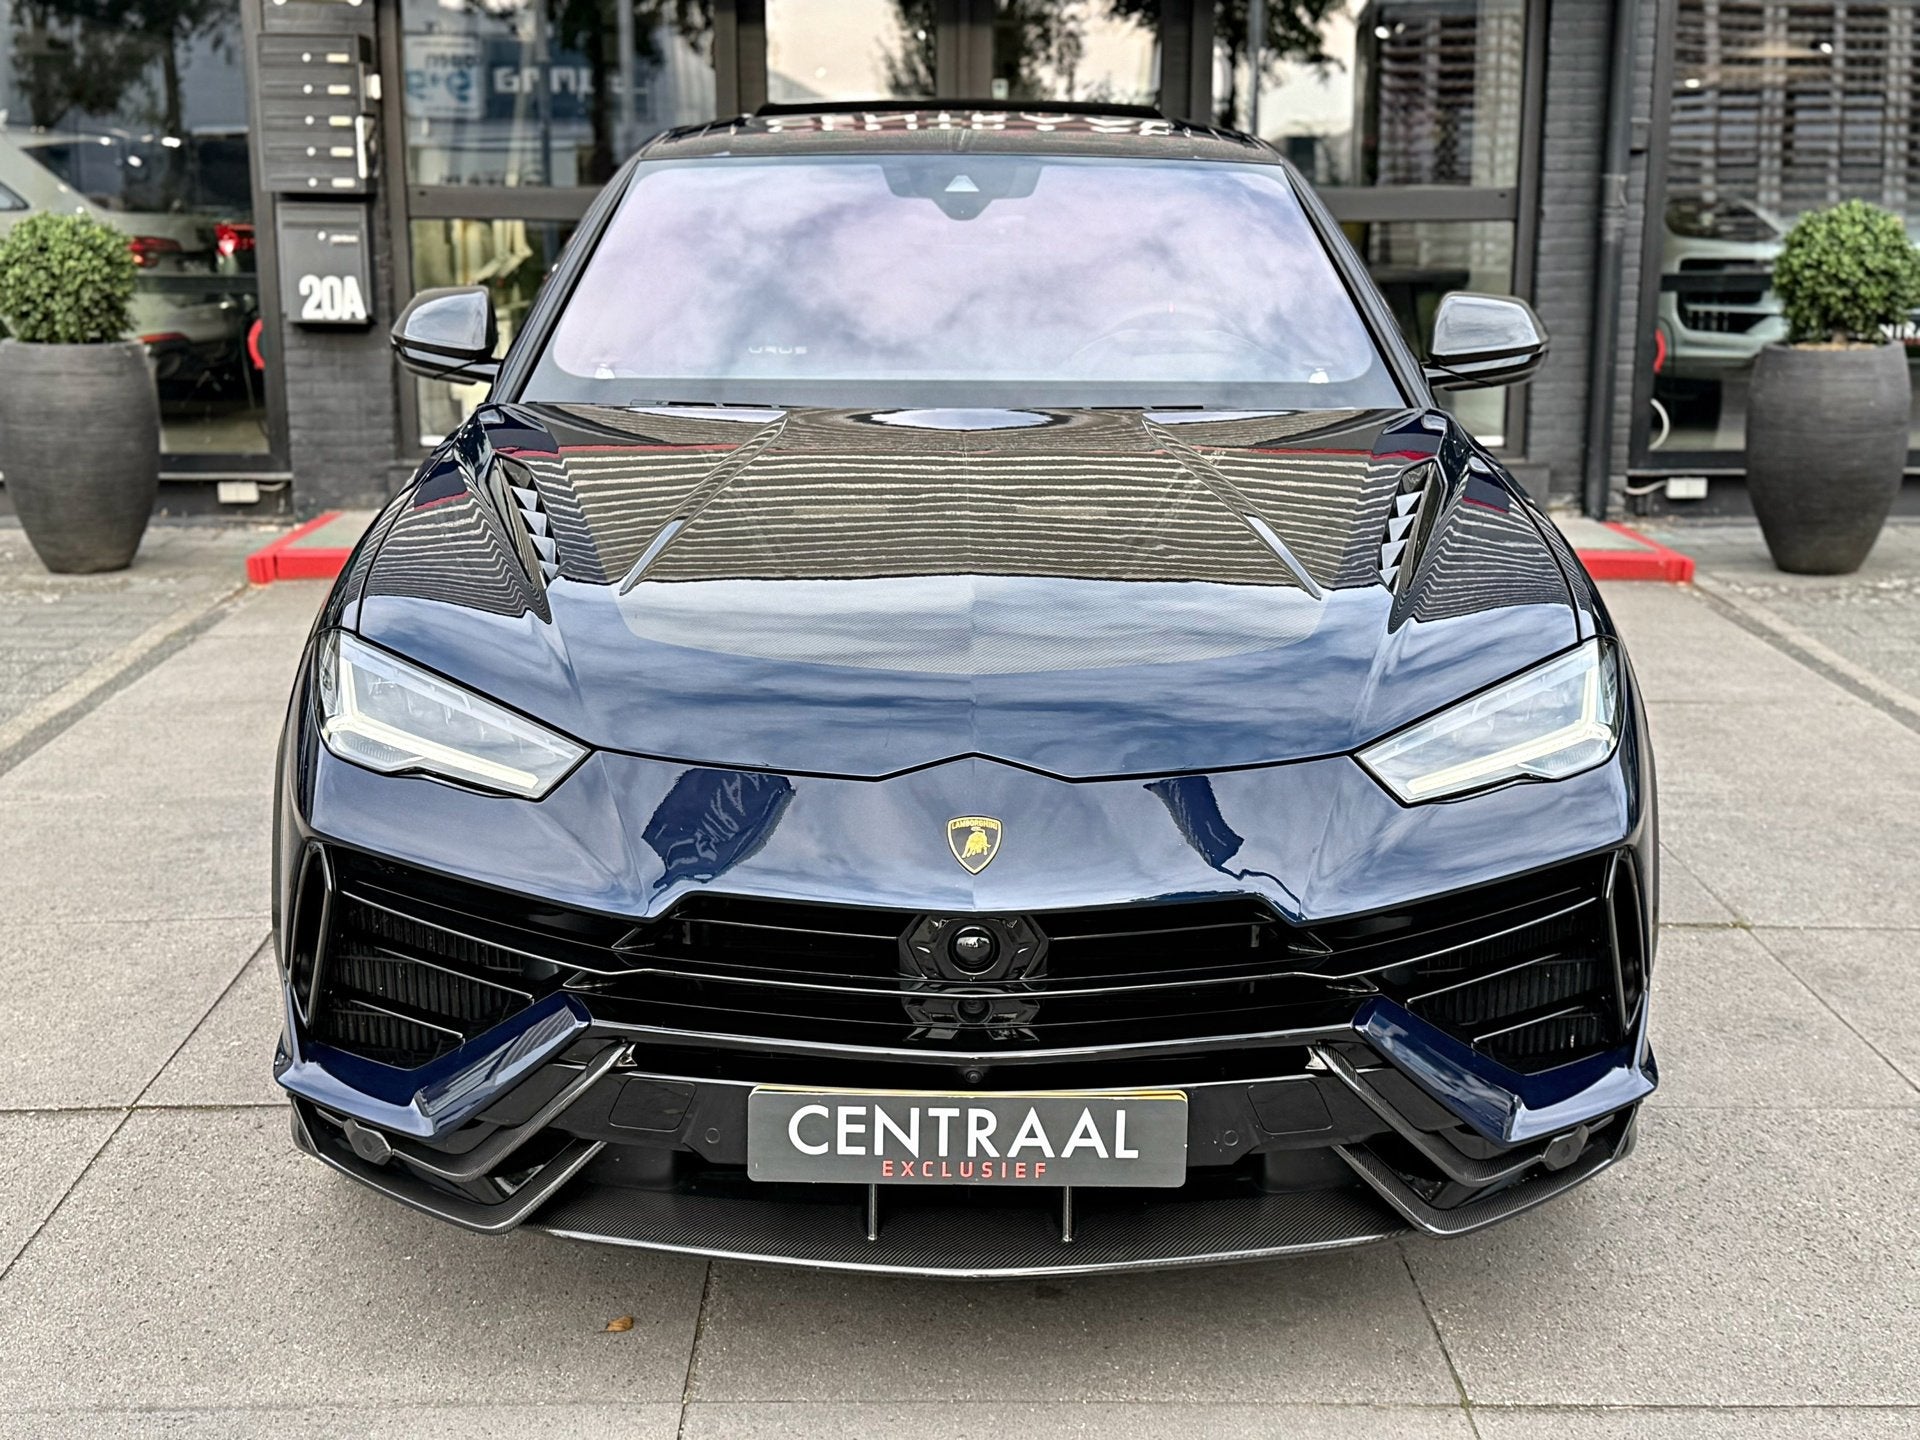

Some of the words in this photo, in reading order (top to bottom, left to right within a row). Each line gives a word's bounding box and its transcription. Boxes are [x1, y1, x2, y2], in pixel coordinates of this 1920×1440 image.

[298, 274, 367, 320] 20A
[951, 819, 998, 830] LAMBORGHINI
[788, 1104, 1139, 1158] CENTRAAL
[882, 1160, 1046, 1179] EXCLUSIEF
